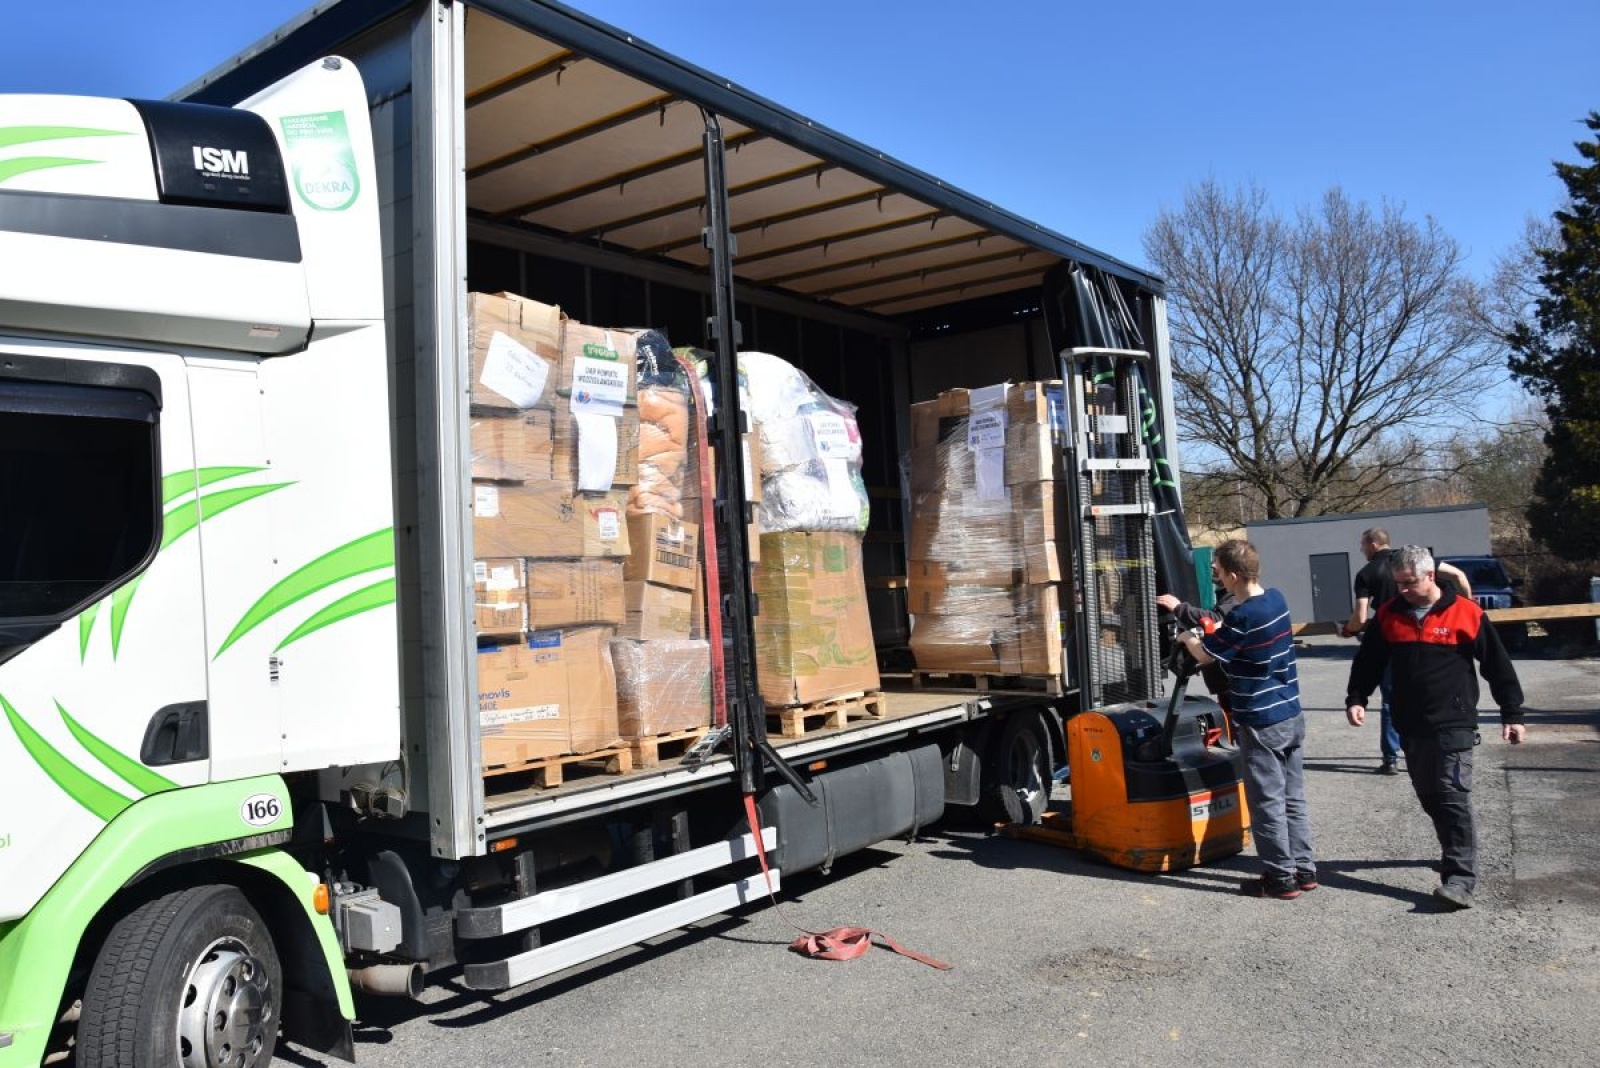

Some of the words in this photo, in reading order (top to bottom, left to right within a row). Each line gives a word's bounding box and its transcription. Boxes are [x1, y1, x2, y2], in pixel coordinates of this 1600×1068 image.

[192, 146, 249, 175] ISM
[304, 180, 350, 194] DEKRA
[247, 798, 279, 820] 166
[1193, 797, 1233, 816] STILL
